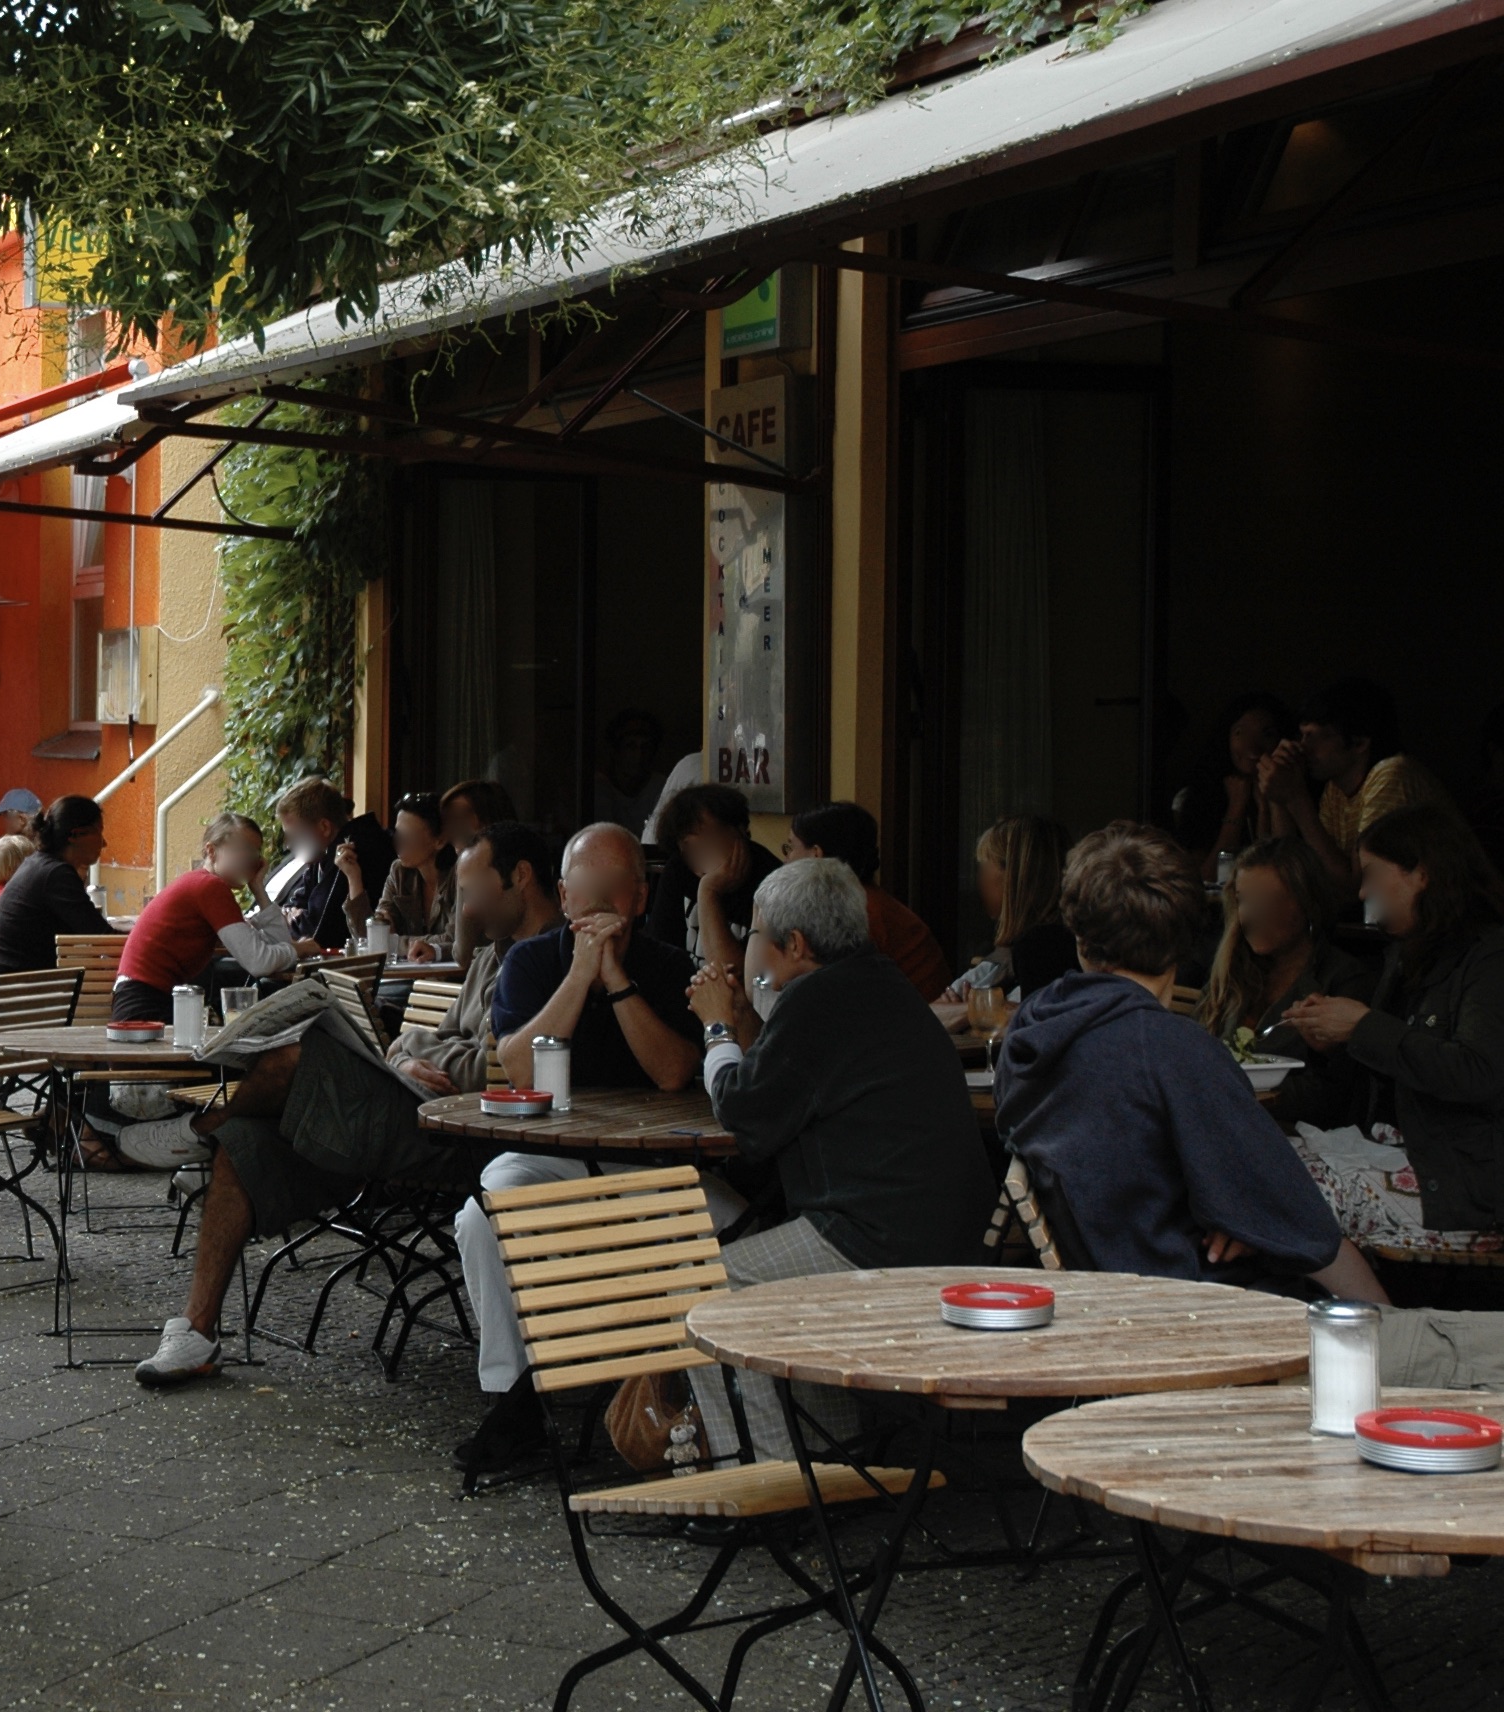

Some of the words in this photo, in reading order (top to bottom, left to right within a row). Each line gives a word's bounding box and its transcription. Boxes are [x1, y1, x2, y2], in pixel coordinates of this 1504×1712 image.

[716, 406, 776, 453] CAFE
[717, 481, 726, 721] COCKTAILS
[762, 547, 772, 651] MEER
[718, 747, 771, 785] BAR
